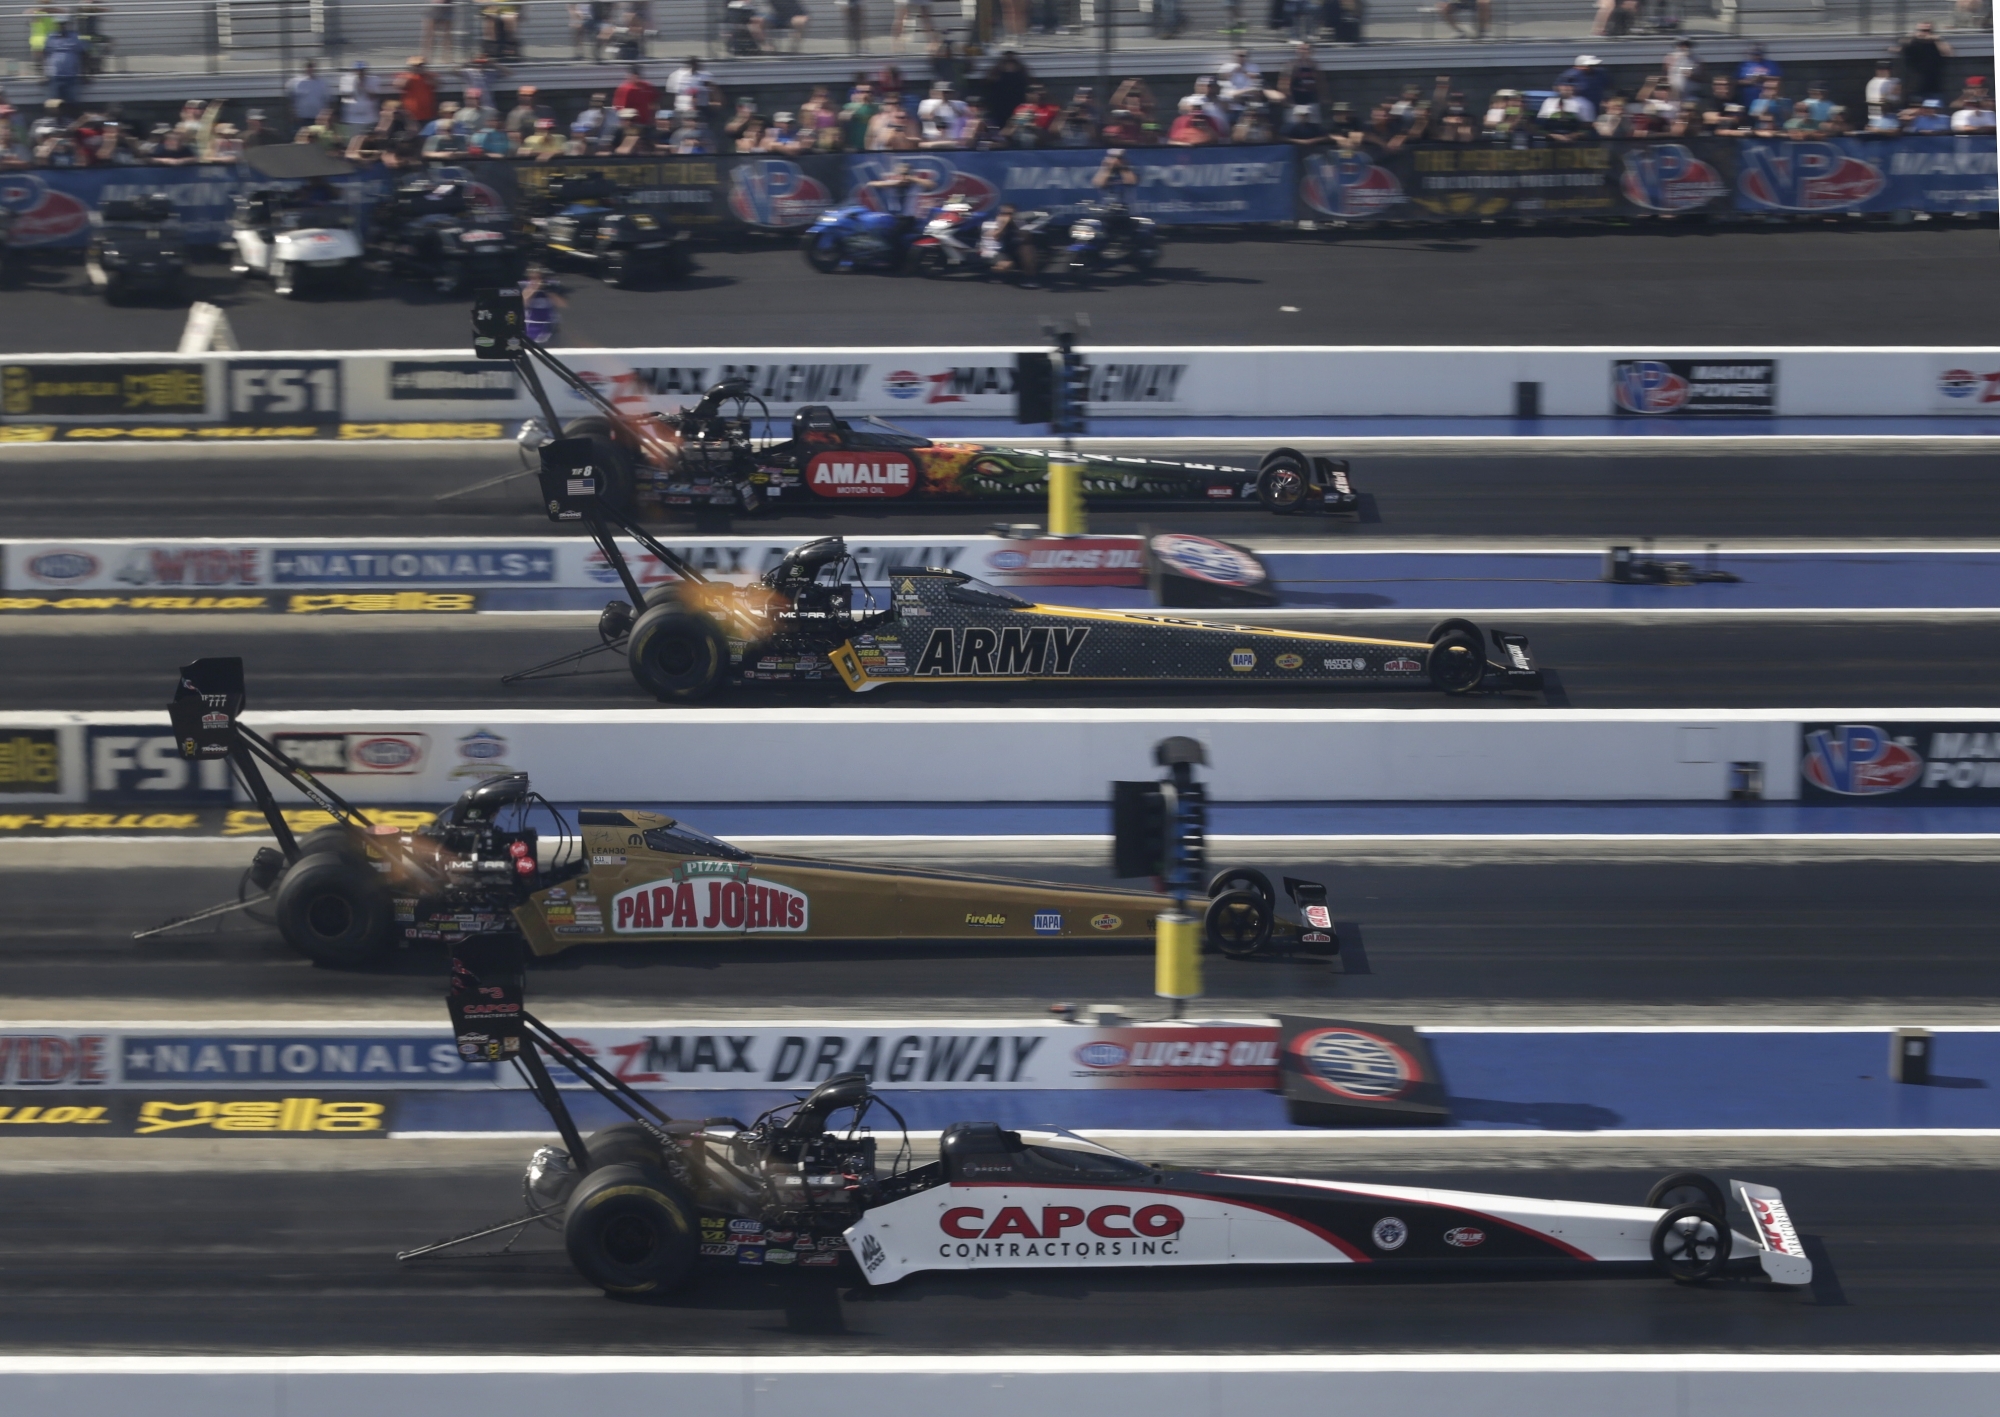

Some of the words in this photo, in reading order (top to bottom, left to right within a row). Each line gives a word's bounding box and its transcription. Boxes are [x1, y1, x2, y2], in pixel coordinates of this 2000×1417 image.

[1742, 141, 1847, 209] VP
[233, 368, 337, 413] FS1
[813, 462, 910, 484] AMALIE
[837, 486, 868, 494] MOTOR
[870, 486, 885, 494] OIL
[296, 553, 530, 577] NATIONALS
[914, 626, 1092, 676] ARMY
[1232, 654, 1254, 666] NAPA
[1805, 724, 1887, 794] VP
[307, 790, 344, 820] GOODYEAR
[687, 861, 735, 874] PIZZA
[617, 882, 698, 929] PAPA
[703, 881, 805, 929] JOHN'S
[965, 913, 1007, 924] FireAde
[1036, 915, 1060, 929] NAPA
[463, 1003, 520, 1014] CAPCO
[155, 1043, 460, 1074] NATIONALS
[766, 1034, 1046, 1083] DRAGWAY
[1128, 1041, 1227, 1067] LUCAS
[1227, 1041, 1280, 1067] OIL
[637, 1117, 682, 1153] GOODYEAR
[729, 1219, 761, 1230] CLEVITE
[939, 1203, 1186, 1240] CAPCO
[729, 1233, 766, 1243] ARP
[1455, 1232, 1468, 1241] RED
[1469, 1232, 1483, 1241] LINE
[701, 1244, 728, 1255] XRP
[939, 1242, 1123, 1258] CONTRACTORS
[1131, 1240, 1179, 1256] INC.
[867, 1251, 886, 1274] TOOLS
